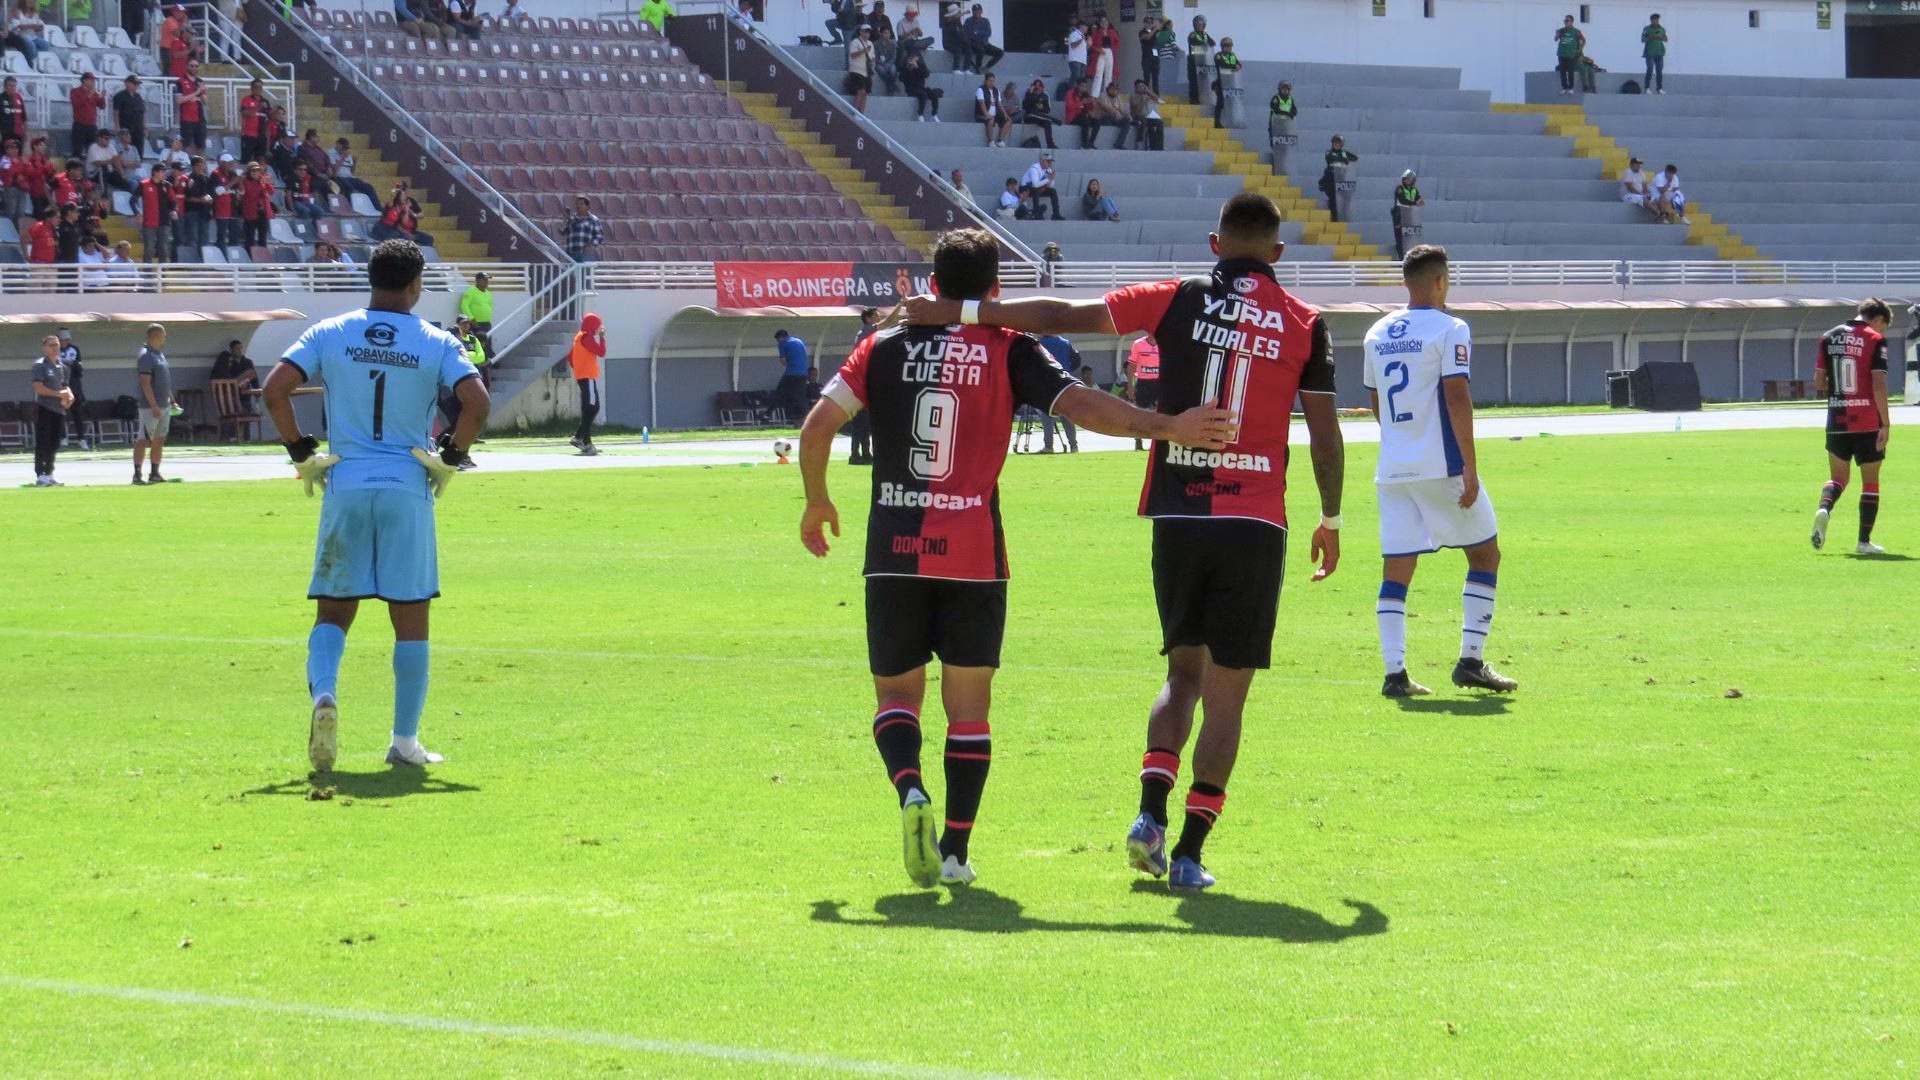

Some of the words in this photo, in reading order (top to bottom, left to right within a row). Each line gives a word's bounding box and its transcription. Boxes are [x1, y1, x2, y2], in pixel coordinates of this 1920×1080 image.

[270, 25, 276, 36] 9
[707, 18, 717, 30] 11
[735, 39, 745, 50] 10
[302, 50, 308, 62] 8
[769, 65, 776, 77] 9
[333, 78, 340, 91] 7
[798, 89, 805, 101] 8
[825, 111, 832, 124] 7
[390, 130, 397, 143] 6
[857, 137, 864, 150] 6
[420, 158, 427, 170] 5
[886, 161, 893, 174] 5
[449, 184, 456, 197] 4
[916, 185, 923, 198] 4
[480, 210, 487, 223] 3
[947, 211, 954, 223] 3
[510, 236, 518, 250] 2
[742, 279, 763, 297] La
[767, 277, 869, 297] ROJINEGRA
[872, 281, 892, 296] es
[1227, 293, 1258, 306] CEMENTO
[1203, 294, 1285, 333] YURA
[933, 334, 964, 343] CEMENTO
[1191, 319, 1281, 360] VIDALES
[1830, 335, 1865, 347] YURA
[1374, 339, 1423, 352] NOBAVISIÓN
[345, 346, 420, 365] NOBAVISIÓN
[904, 341, 988, 364] YURA
[902, 361, 981, 385] CUESTA
[1832, 355, 1858, 395] 10
[1384, 360, 1414, 424] 2
[369, 369, 386, 441] 1
[909, 387, 960, 482] 9
[1166, 441, 1271, 473] Ricocan
[878, 482, 982, 510] Ricocan
